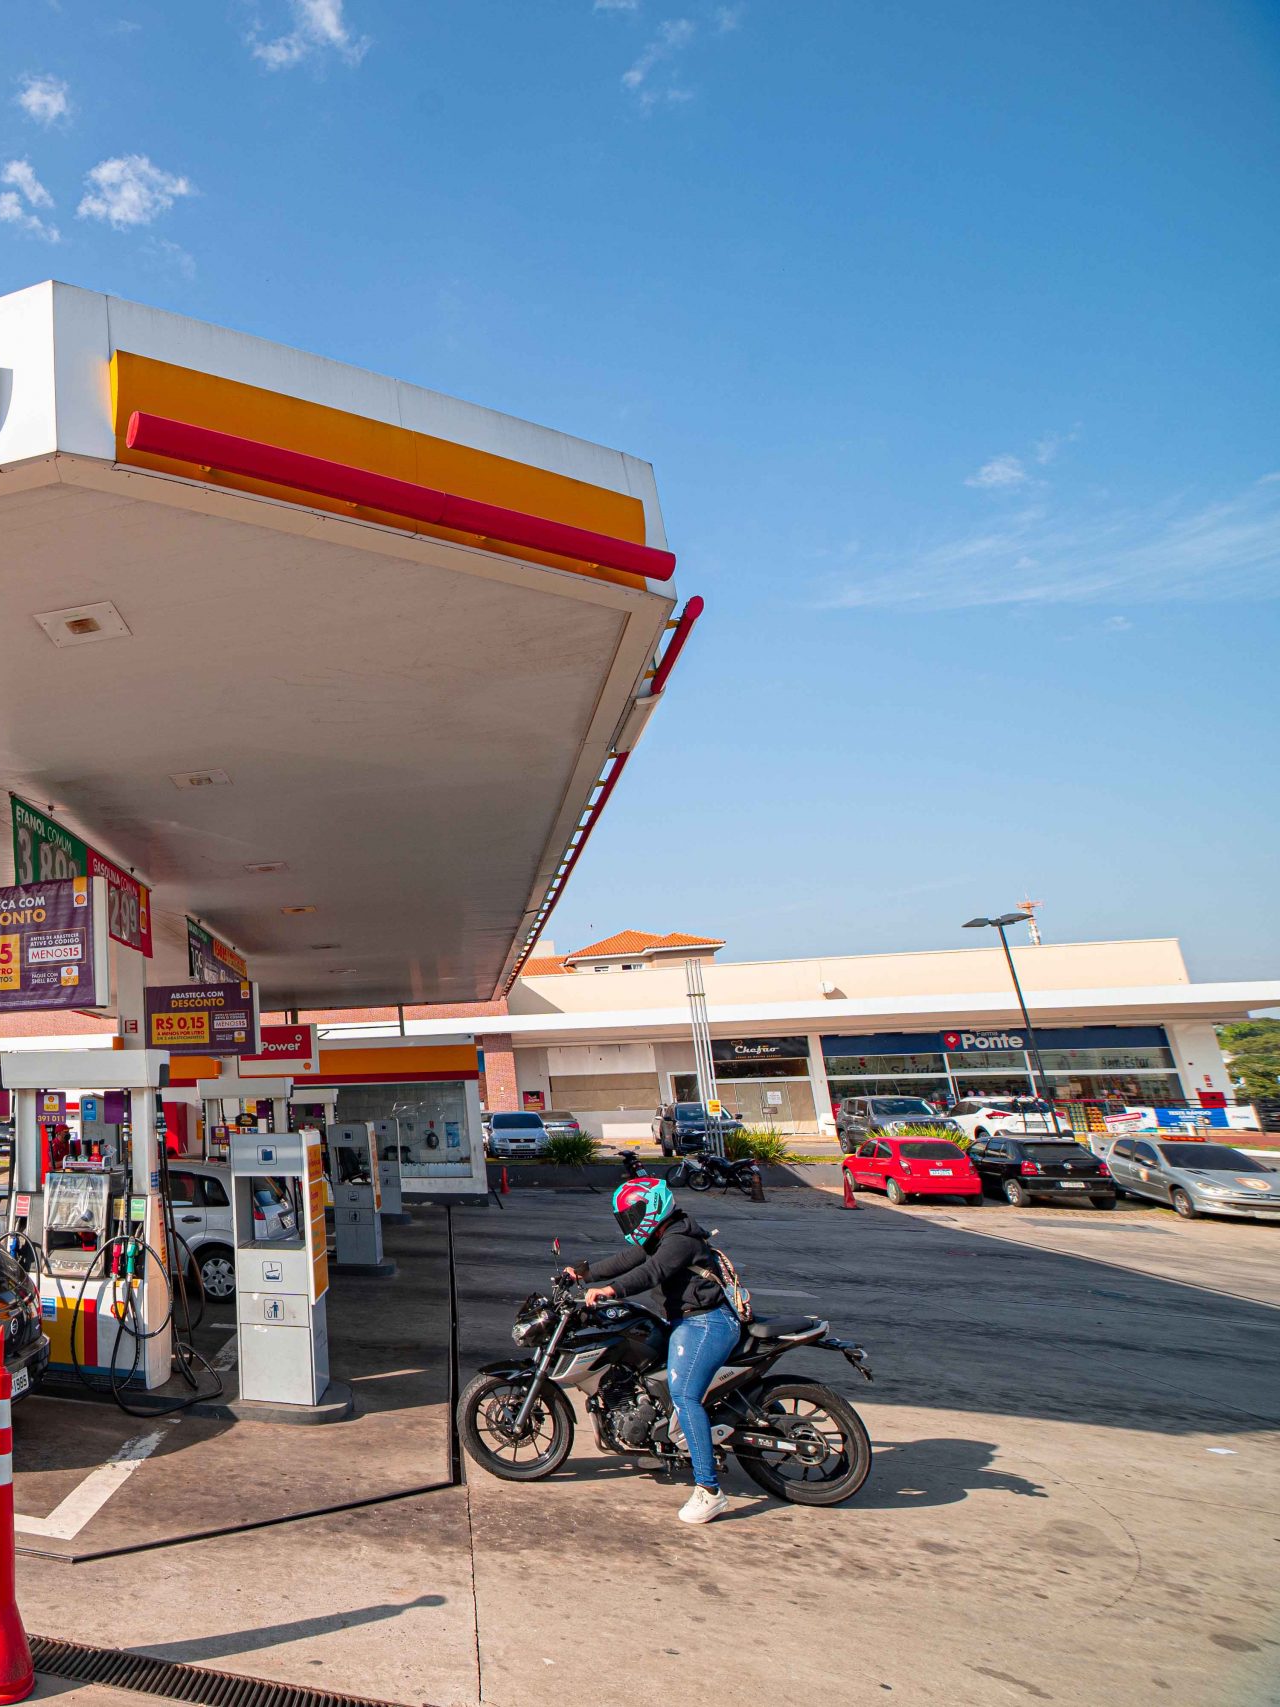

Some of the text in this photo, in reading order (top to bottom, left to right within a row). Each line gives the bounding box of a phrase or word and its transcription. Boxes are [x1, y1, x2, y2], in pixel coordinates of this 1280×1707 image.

[15, 805, 73, 856] ETANOL COMUM
[92, 858, 121, 885] GASOLINA
[19, 896, 46, 908] COM
[54, 936, 80, 945] CÓDIGO
[31, 947, 79, 960] MENOS15
[171, 992, 205, 1000] ABASTEÇA
[171, 997, 225, 1008] DESCONTO
[155, 1016, 205, 1031] R$ 0,15
[260, 1041, 301, 1052] Power
[960, 1032, 1024, 1050] Ponte
